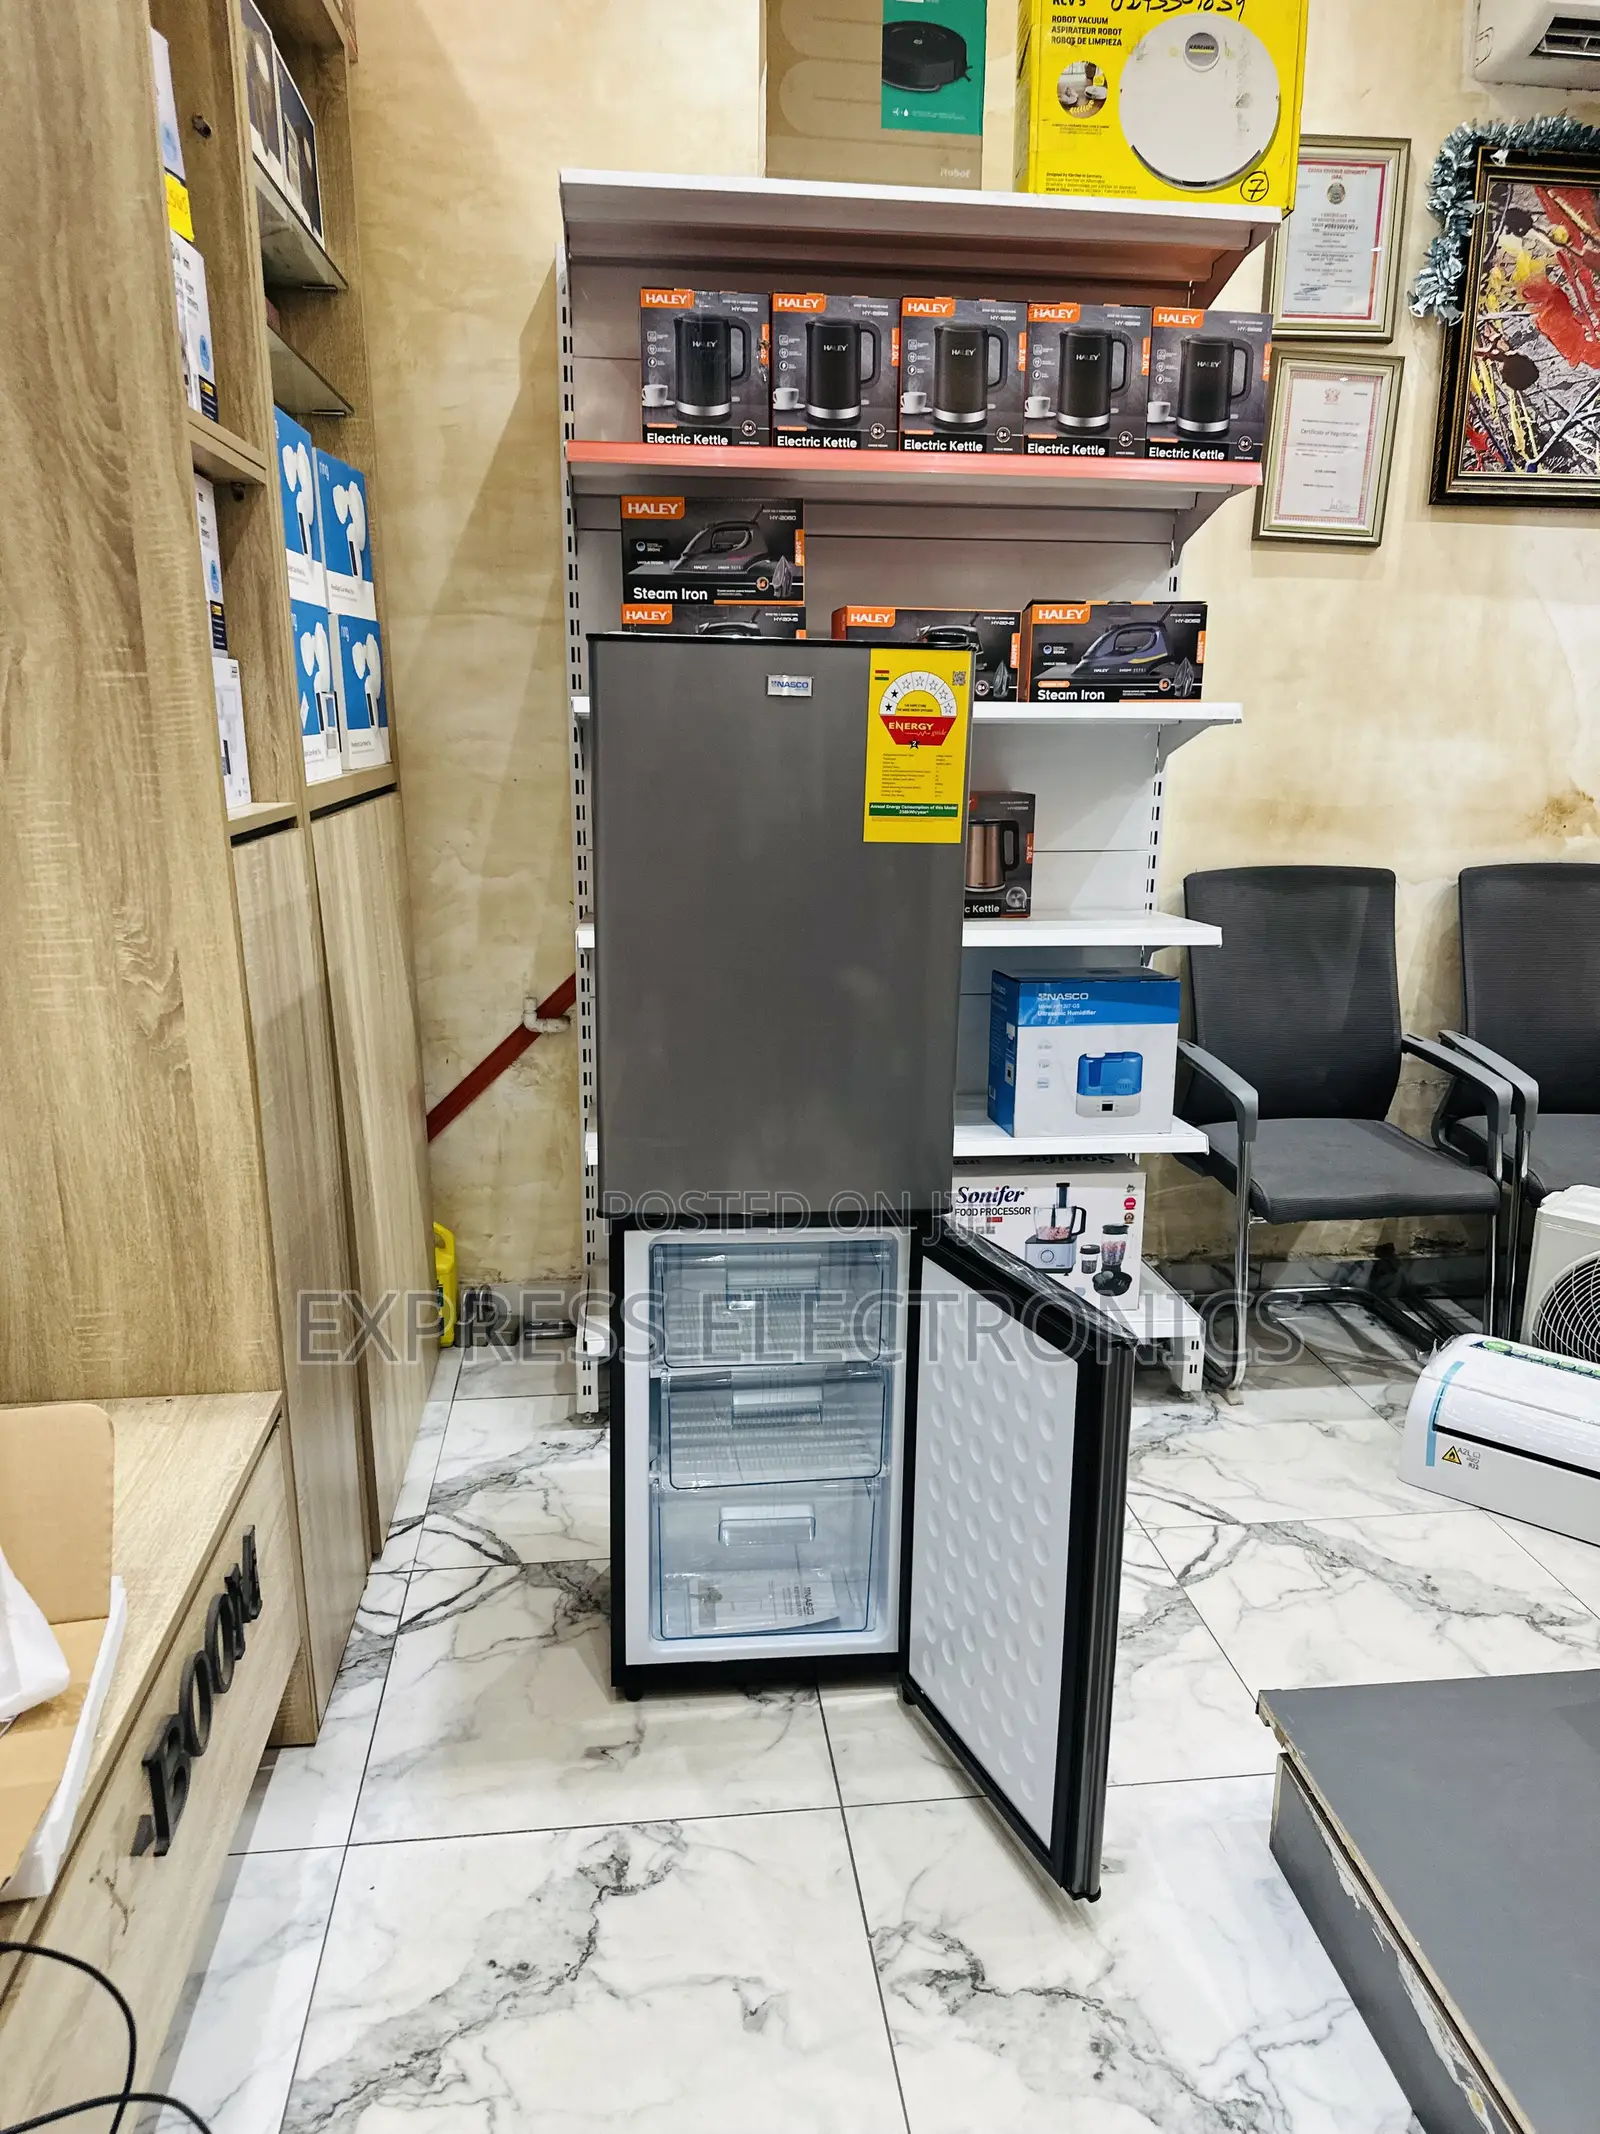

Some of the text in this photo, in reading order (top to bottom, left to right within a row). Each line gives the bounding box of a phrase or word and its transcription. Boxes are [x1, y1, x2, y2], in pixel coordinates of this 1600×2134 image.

[1051, 15, 1109, 25] ROBOT VACUUM
[1051, 25, 1123, 36] ASPIRATEUR ROBOT
[1051, 36, 1123, 47] ROBOT DE LIMPIEZA
[1249, 179, 1266, 200] 7
[645, 294, 687, 304] HALEY
[777, 298, 820, 308] HALEY
[907, 303, 949, 313] HALEY
[1033, 308, 1074, 318] HALEY
[1158, 313, 1198, 324] HALEY
[1300, 428, 1324, 436] Certificate
[646, 432, 729, 446] Electric Kettle
[777, 436, 822, 447] Electric
[823, 437, 858, 449] Kettle
[904, 439, 984, 452] Electric Kettle
[1027, 443, 1106, 456] Electric Kettle
[1148, 447, 1225, 460] Electric Kettle
[319, 459, 330, 481] ring
[627, 502, 678, 515] HALEY
[633, 588, 678, 600] Steam
[681, 588, 708, 600] Iron
[626, 611, 667, 620] HALEY
[850, 613, 890, 623] HALEY
[1038, 609, 1084, 620] HALEY
[776, 681, 809, 689] NASCO
[1037, 689, 1105, 701] Steam Iron
[888, 720, 934, 732] ENERGY
[972, 904, 1000, 913] Kettle
[1047, 992, 1089, 1001] NASCO
[956, 1185, 1025, 1206] Sonifer
[954, 1206, 1031, 1217] FOOD PROCESSOR
